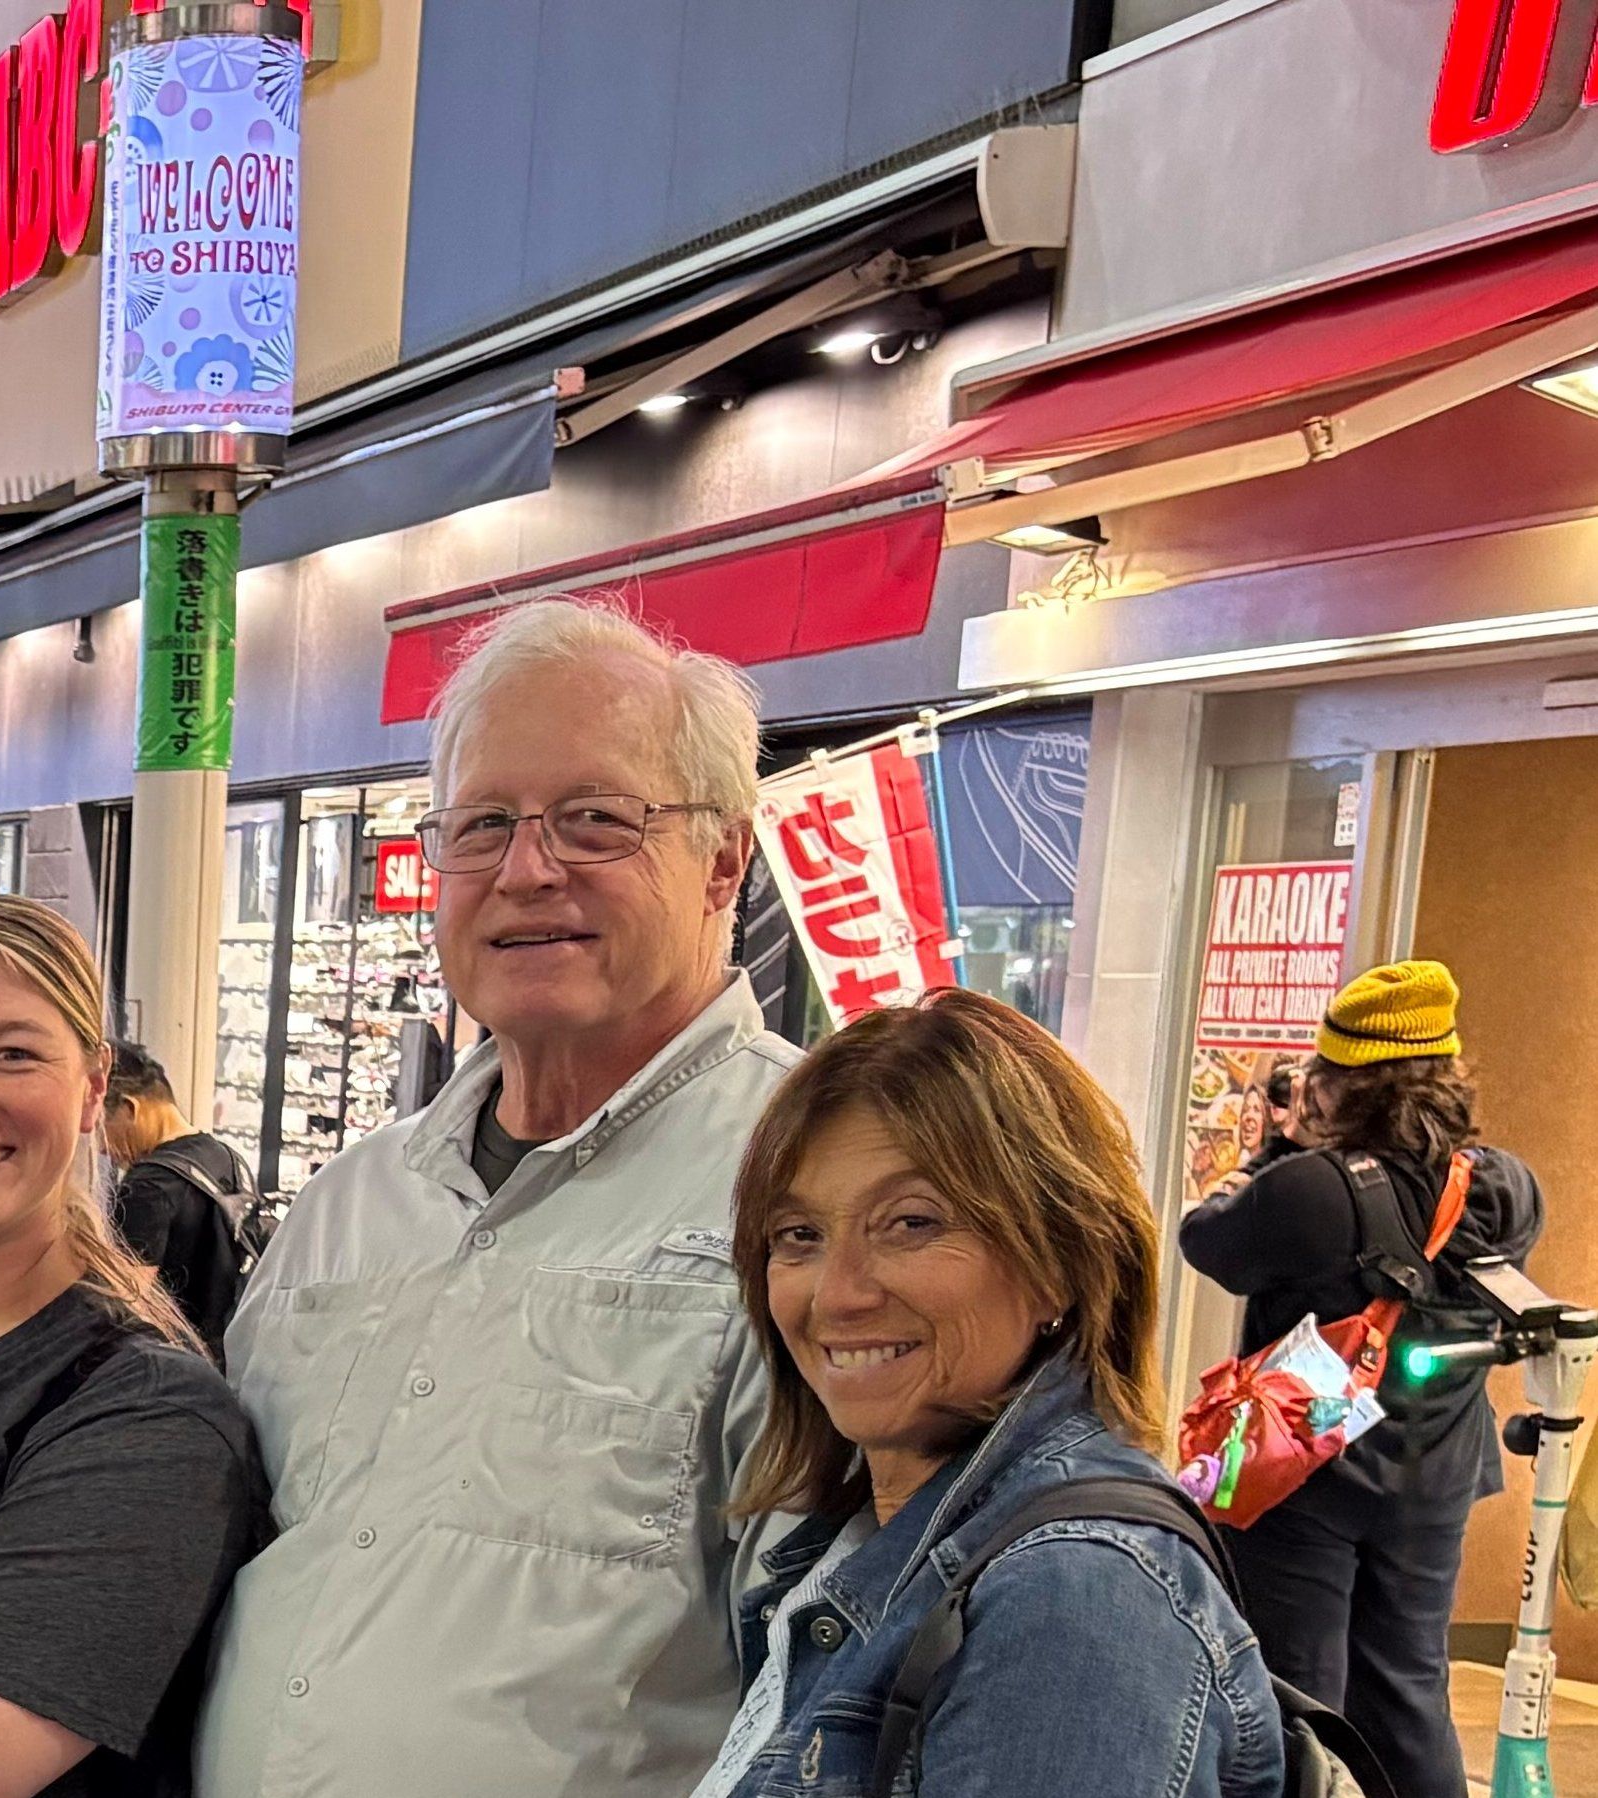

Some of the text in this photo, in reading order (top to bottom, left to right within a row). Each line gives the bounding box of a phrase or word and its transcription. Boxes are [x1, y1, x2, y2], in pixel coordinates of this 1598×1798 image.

[137, 152, 295, 234] WELCOME
[130, 248, 165, 275] TO
[169, 530, 209, 757] 落書きは犯罪です
[1211, 871, 1349, 945] KARAOKE
[1206, 949, 1340, 985] ALL PRIVATE ROOMS
[1200, 986, 1226, 1020] ALL
[1227, 986, 1255, 1020] YOU
[1255, 986, 1285, 1020] CAN
